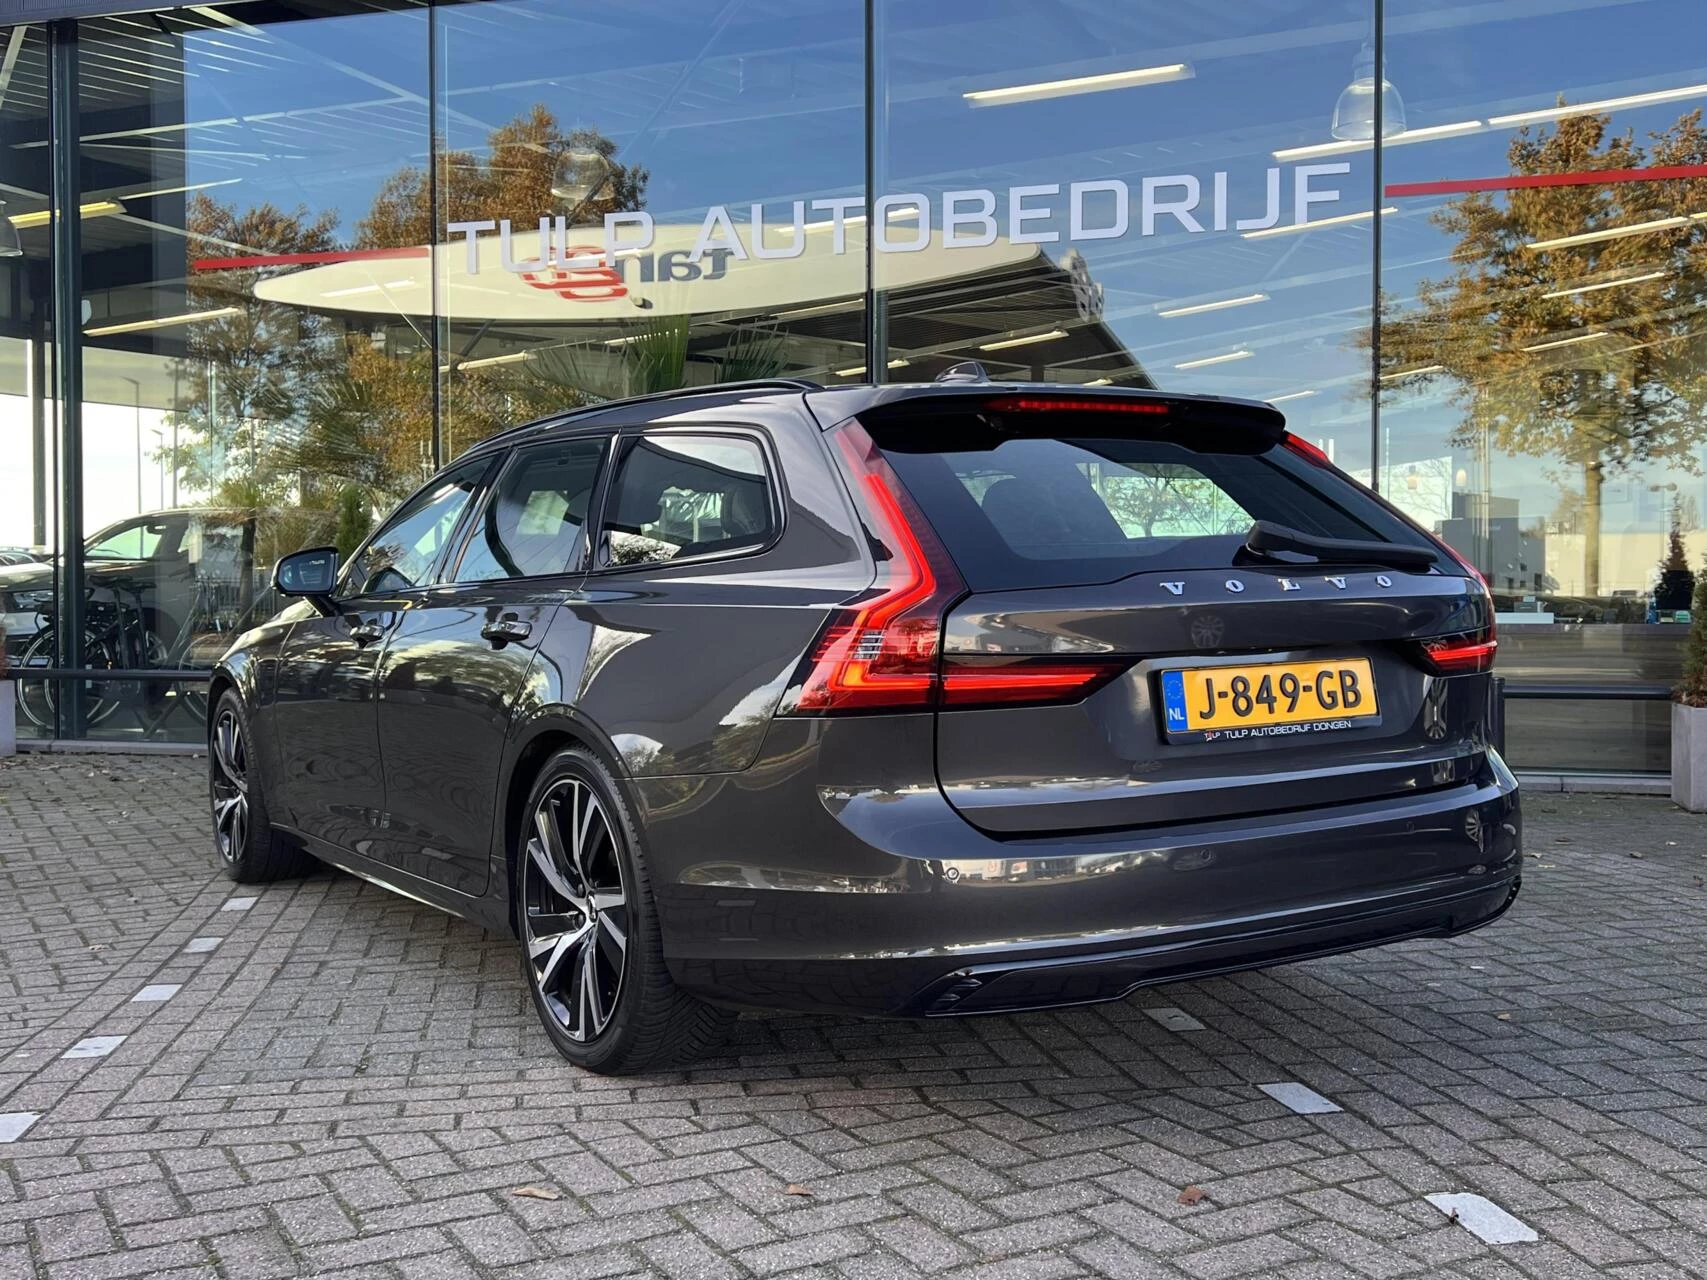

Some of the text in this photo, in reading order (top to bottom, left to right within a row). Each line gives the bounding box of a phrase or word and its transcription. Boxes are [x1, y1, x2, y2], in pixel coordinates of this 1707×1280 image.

[448, 162, 1351, 274] TULP AUTOBEDRIJF
[1160, 575, 1393, 595] VOLVO
[1199, 669, 1362, 720] J-849-GB
[1169, 707, 1184, 720] NL
[1225, 730, 1249, 739] TULP
[1250, 724, 1312, 737] AUTOBEDRIJF
[1313, 720, 1352, 731] DONGEN
